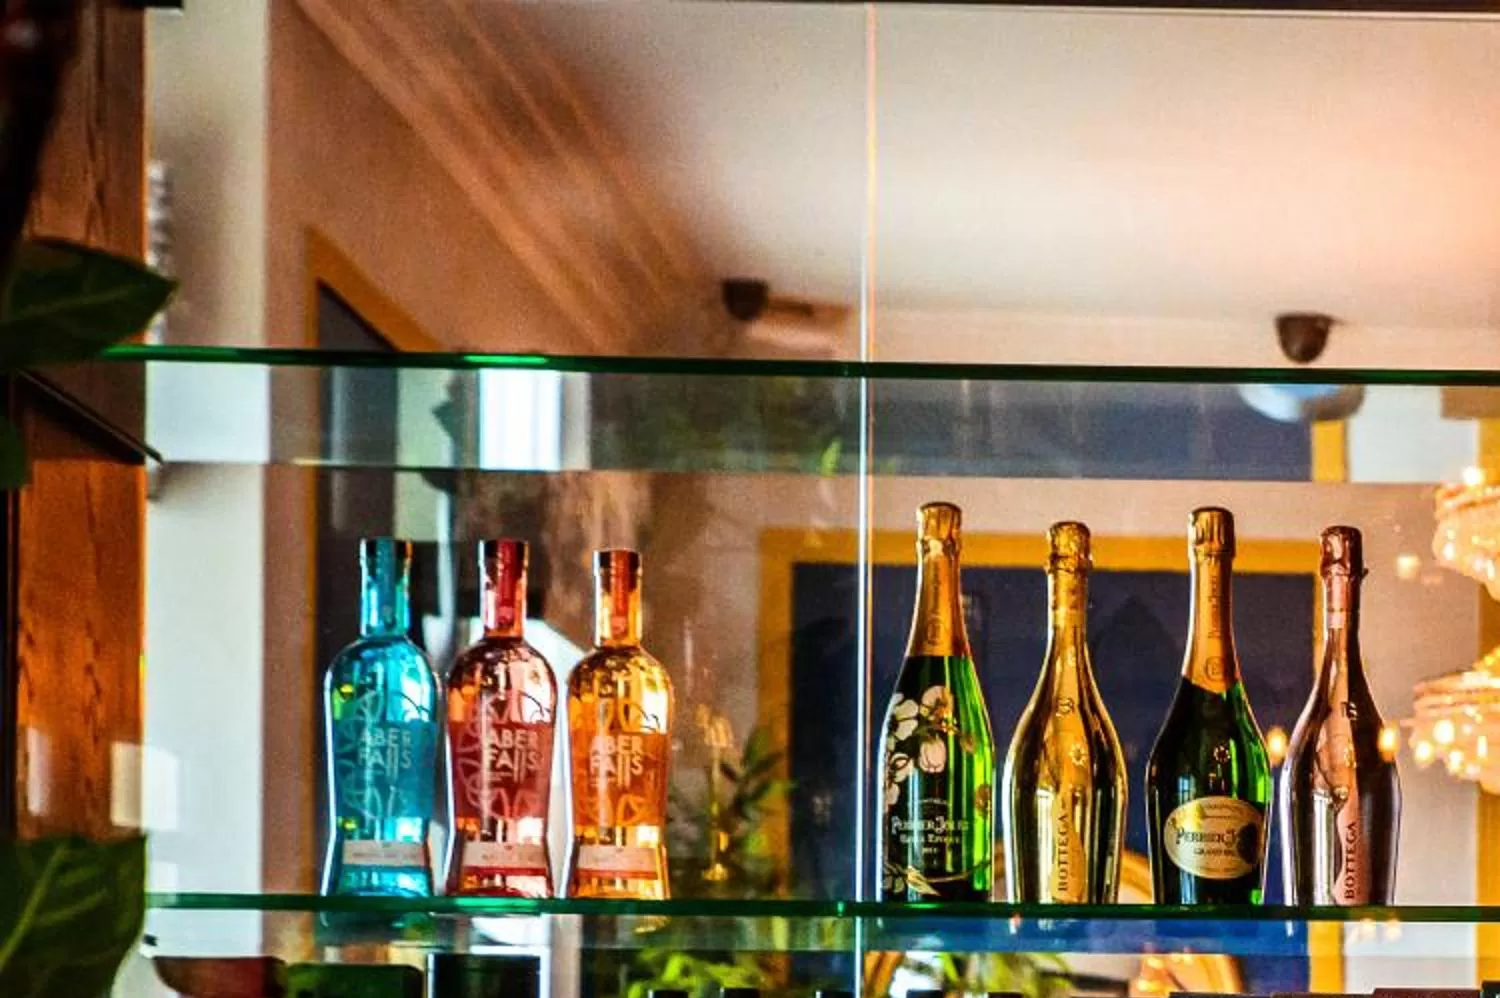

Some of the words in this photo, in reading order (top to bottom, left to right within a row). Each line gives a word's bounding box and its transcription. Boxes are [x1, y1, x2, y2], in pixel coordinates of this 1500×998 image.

[360, 728, 411, 748] ABER
[486, 729, 538, 749] ABER
[591, 735, 644, 754] ABER
[358, 749, 412, 783] FALLS
[484, 749, 541, 783] FALLS
[590, 754, 643, 788] FALLS
[1057, 812, 1069, 891] BOTTEGA
[1344, 822, 1357, 899] BOTTEGA
